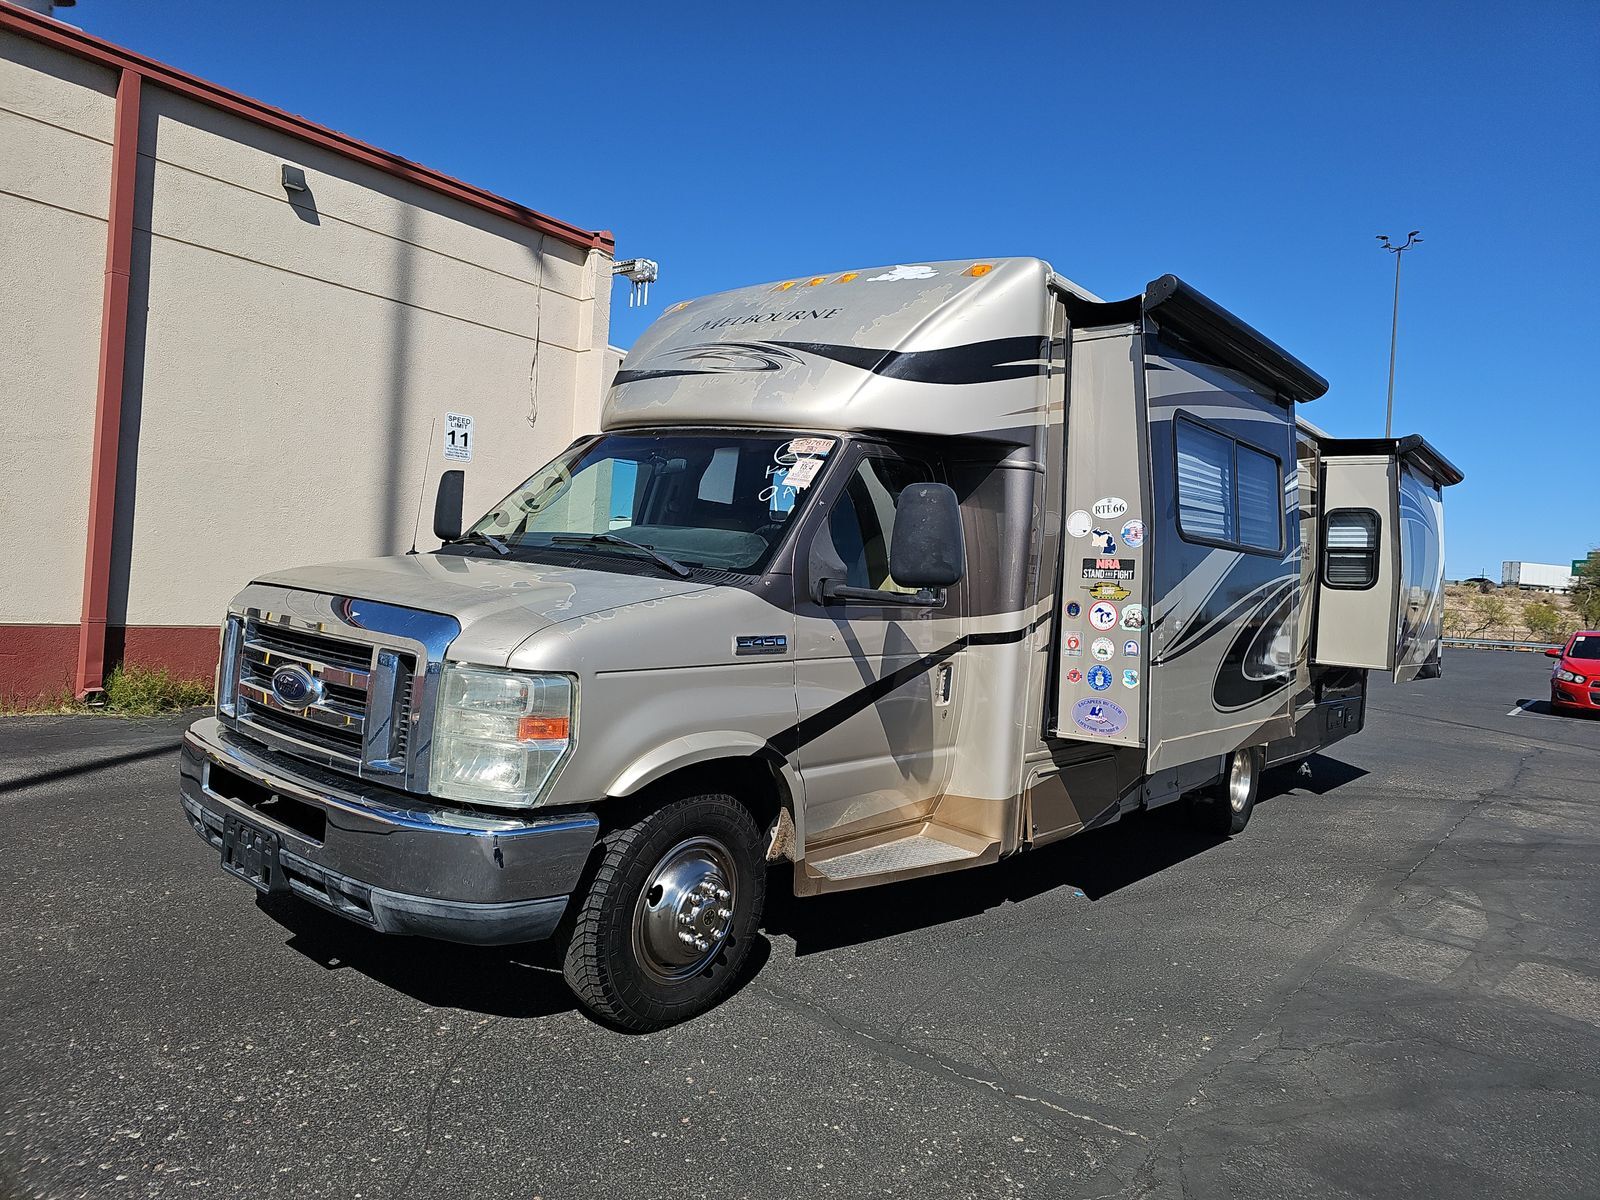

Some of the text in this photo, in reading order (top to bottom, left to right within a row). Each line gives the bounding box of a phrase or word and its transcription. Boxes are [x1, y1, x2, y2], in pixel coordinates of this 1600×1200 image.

[692, 307, 845, 332] MELBOURNE
[448, 415, 471, 424] SPEED
[447, 430, 468, 447] 11
[1096, 559, 1120, 569] NRA
[1083, 569, 1105, 578] STAND
[1113, 570, 1133, 579] FIGHT
